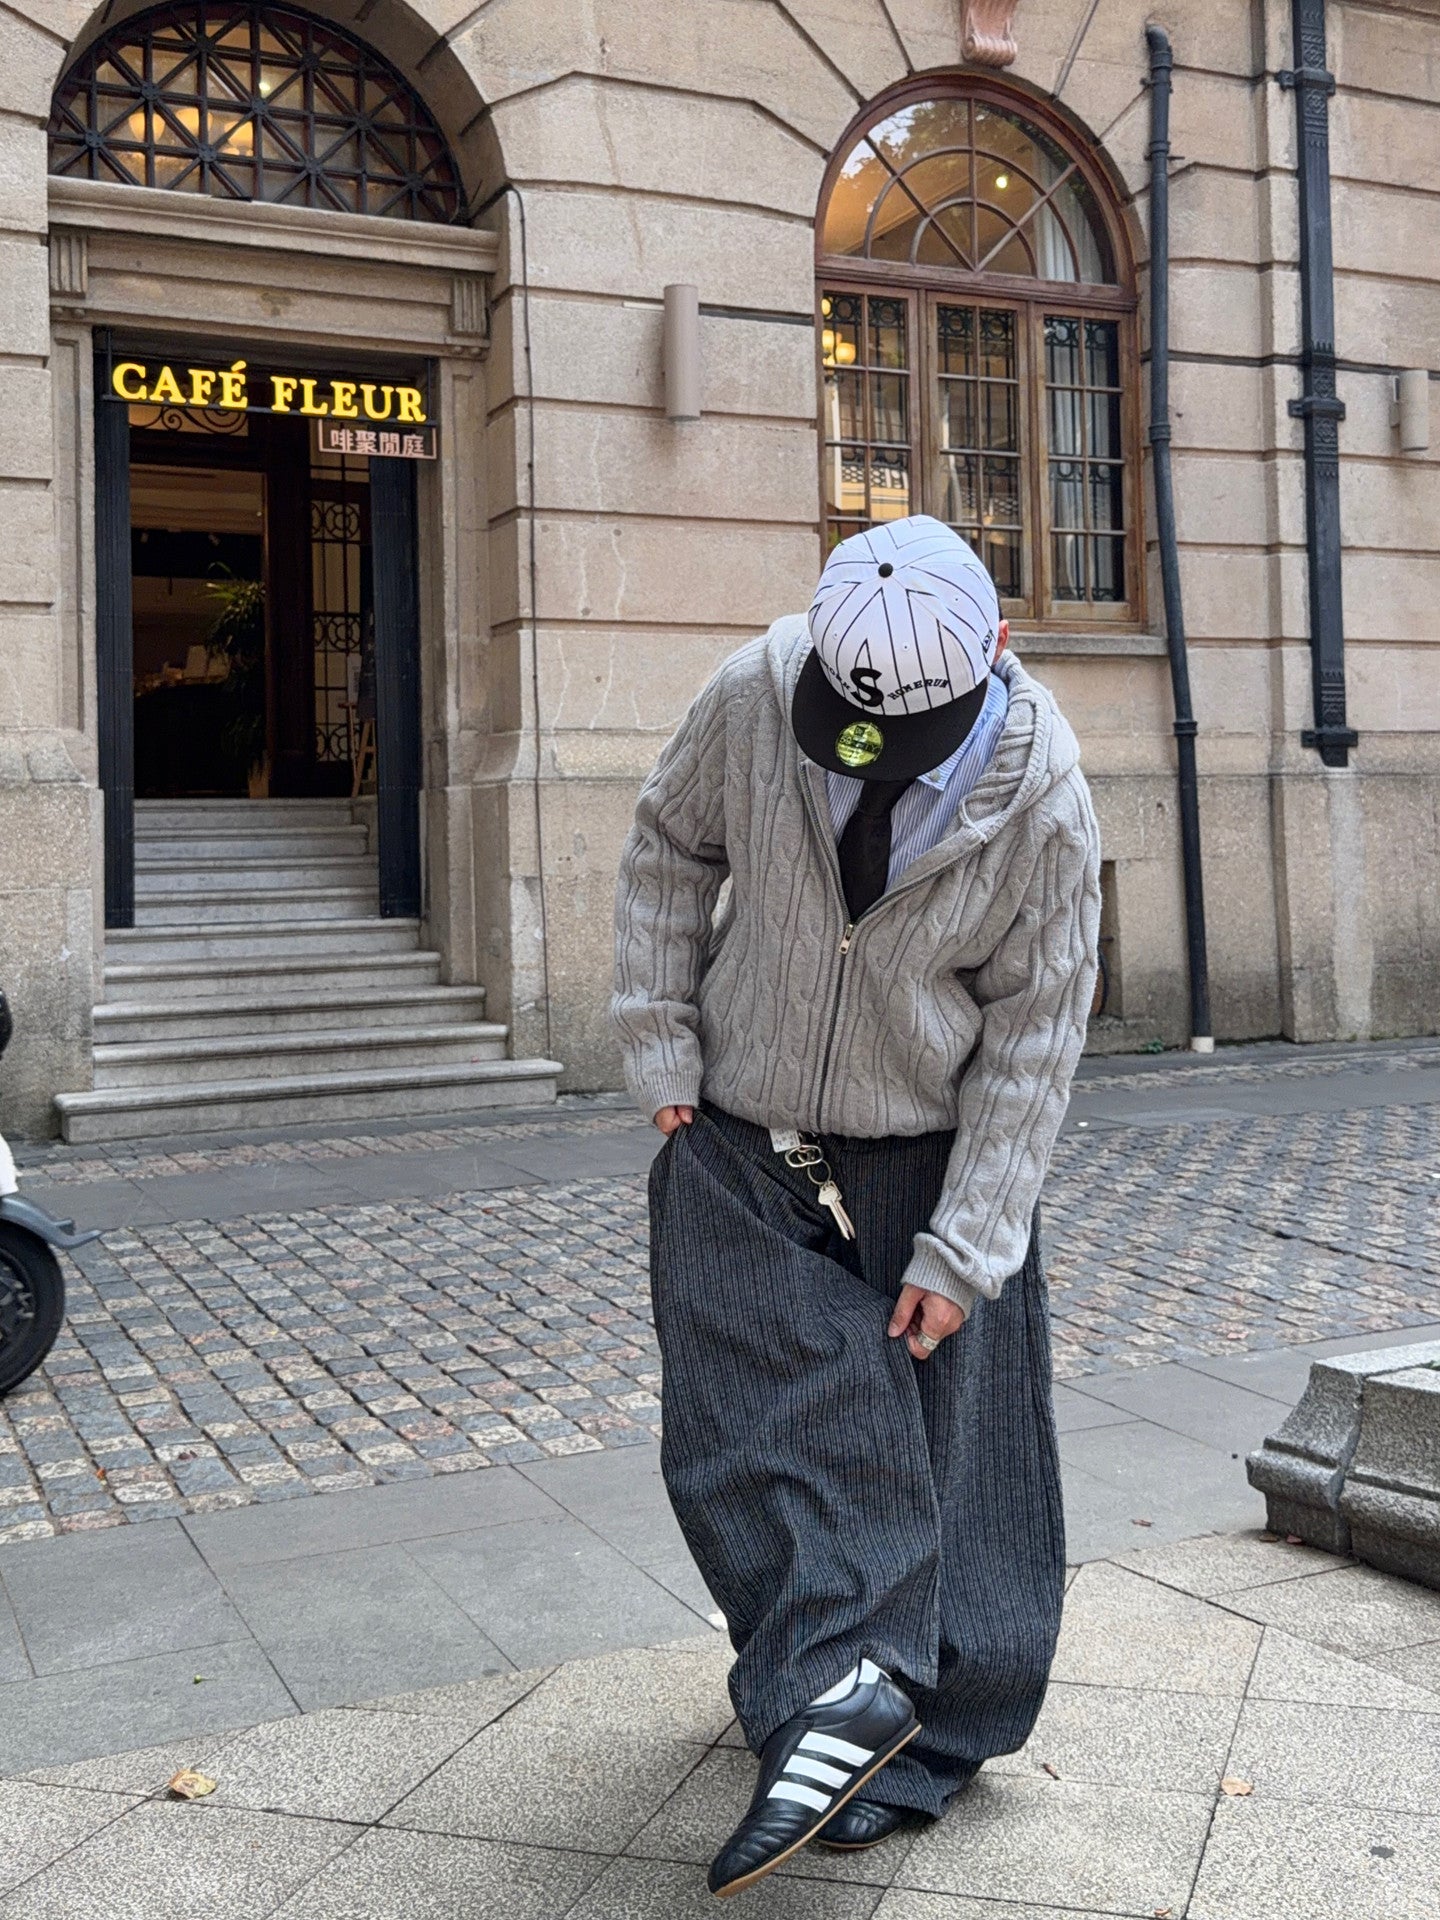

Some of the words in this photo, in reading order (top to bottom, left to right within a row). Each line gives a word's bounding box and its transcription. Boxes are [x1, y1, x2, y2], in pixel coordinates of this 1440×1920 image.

[112, 361, 248, 409] CAFÉ
[270, 376, 427, 422] FLEUR
[850, 667, 884, 707] S
